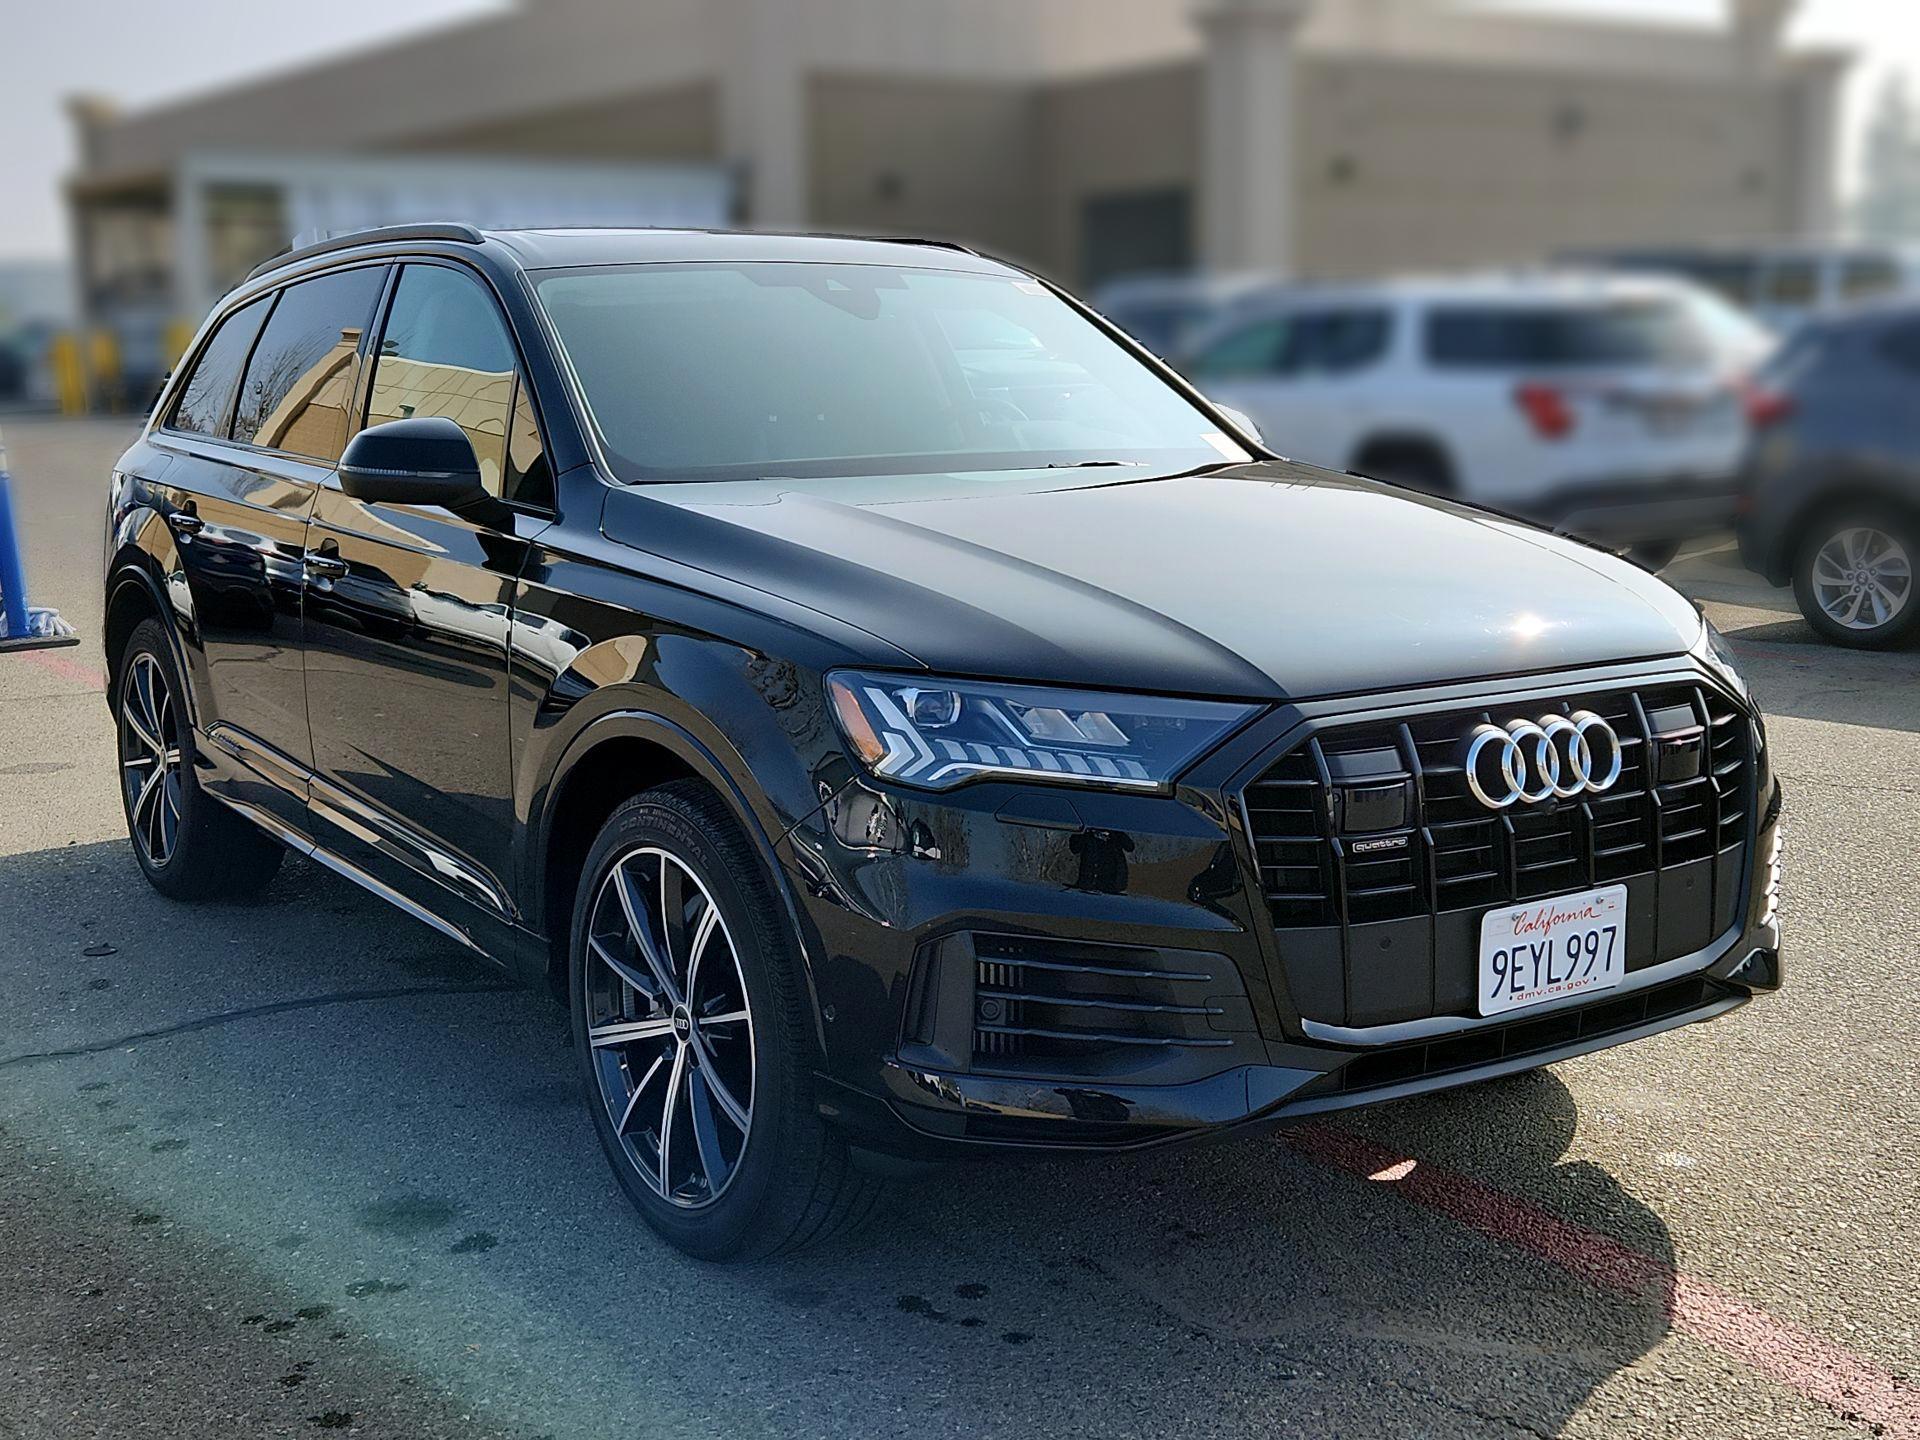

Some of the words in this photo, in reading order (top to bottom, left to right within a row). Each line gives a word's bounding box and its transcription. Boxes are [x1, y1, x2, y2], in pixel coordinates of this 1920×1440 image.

[1356, 838, 1406, 852] quattro
[1514, 905, 1601, 936] California
[1491, 925, 1617, 998] 9EYL997
[1517, 978, 1590, 1001] dmv.ca.gov
